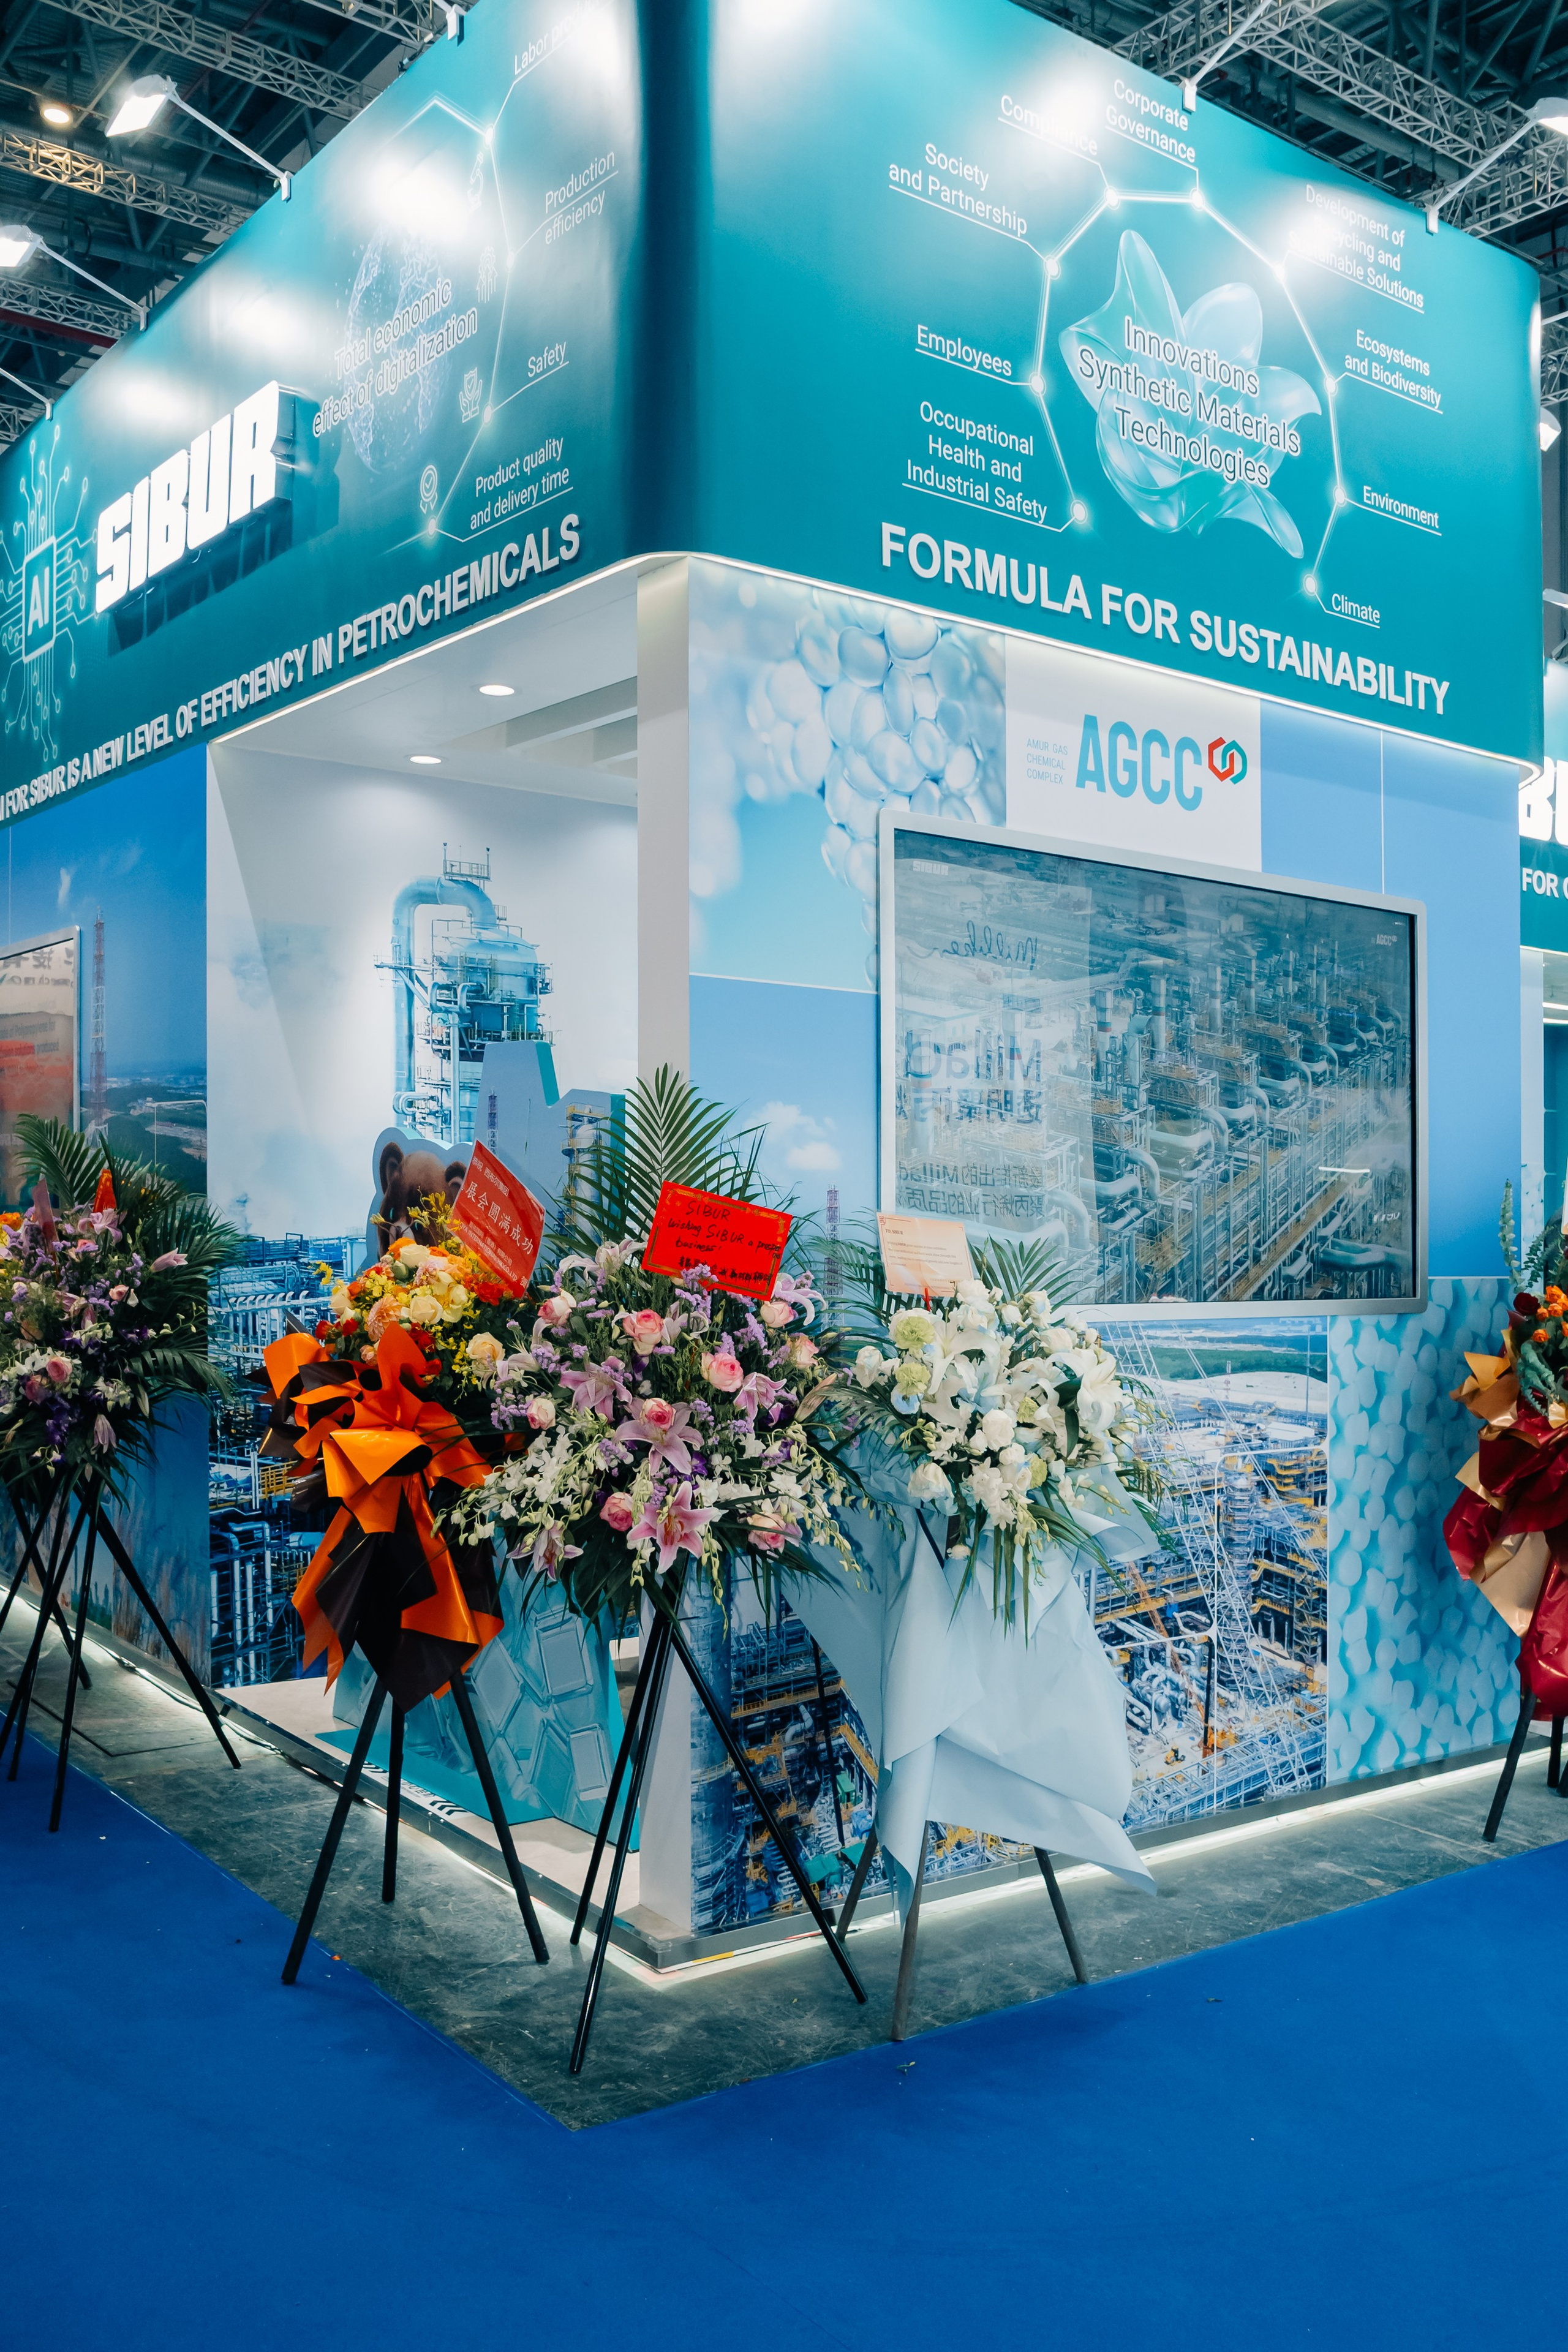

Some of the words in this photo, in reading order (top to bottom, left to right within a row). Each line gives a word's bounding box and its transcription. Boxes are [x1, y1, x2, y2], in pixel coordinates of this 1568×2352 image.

[514, 33, 548, 75] Labor
[1000, 94, 1098, 156] Compliance
[1114, 78, 1188, 132] Corporate
[1106, 105, 1196, 163] Governance
[545, 151, 615, 214] Production
[925, 143, 989, 191] Society
[545, 189, 606, 245] efficiency
[889, 163, 922, 192] and
[929, 175, 1028, 236] Partnership
[1306, 184, 1389, 240] Development
[1392, 229, 1406, 247] of
[1367, 267, 1424, 308] Solutions
[1378, 250, 1401, 272] and
[334, 327, 371, 380] Total
[374, 277, 451, 354] economic
[917, 324, 1012, 376] Employees
[1356, 329, 1430, 377] Ecosystems
[312, 386, 353, 437] effect
[356, 369, 374, 407] of
[375, 307, 478, 396] digitalization
[527, 341, 567, 378] Safety
[1124, 315, 1260, 398] Innovations
[1344, 354, 1368, 377] and
[1371, 361, 1441, 409] Biodiversity
[1078, 344, 1191, 417] Synthetic
[1196, 390, 1300, 456] Materials
[919, 401, 1034, 456] Occupational
[1114, 405, 1270, 488] Technologies
[475, 466, 521, 497] Product
[522, 437, 564, 480] quality
[928, 434, 986, 471] Health
[990, 462, 1022, 483] and
[95, 380, 283, 614] SIBUR
[470, 502, 491, 530] and
[494, 483, 539, 521] delivery
[541, 467, 570, 494] time
[907, 459, 989, 503] Industrial
[994, 486, 1047, 524] Safety
[1363, 485, 1439, 529] Environment
[27, 567, 50, 636] AI
[881, 522, 1092, 620] FORMULA
[1101, 584, 1181, 644] FOR
[1189, 609, 1450, 716] SUSTAINABILITY
[1332, 593, 1381, 624] Climate
[6, 784, 29, 818] FOR
[29, 765, 66, 807] SIBUR
[67, 758, 80, 790] IS
[81, 753, 92, 783] A
[92, 735, 125, 778] NEW
[127, 714, 174, 763] LEVEL
[176, 698, 198, 739] OF
[201, 644, 309, 728] EFFICIENCY
[312, 632, 333, 677] IN
[338, 513, 581, 664] PETROCHEMICALS
[1027, 737, 1049, 752] AMUR
[1052, 743, 1068, 756] GAS
[1027, 753, 1066, 771] CHEMICAL
[1075, 714, 1203, 812] AGCC
[1027, 768, 1063, 785] COMPLEX
[912, 860, 949, 876] SIBUR
[1522, 867, 1559, 899] FOR
[465, 1181, 533, 1255] 展会圆满成功
[685, 1200, 731, 1222] SIBUR
[706, 1224, 745, 1245] SIBUR
